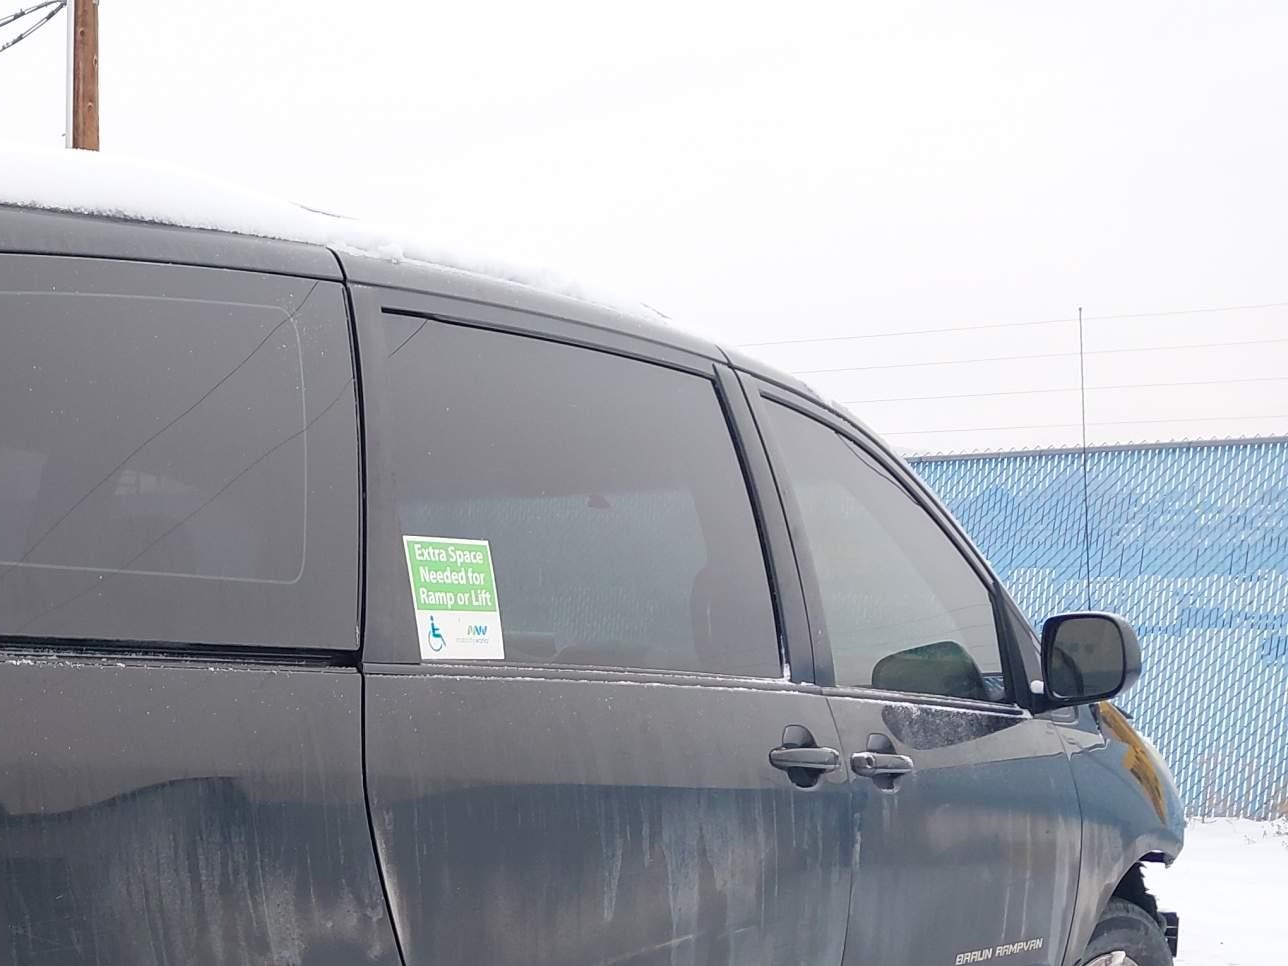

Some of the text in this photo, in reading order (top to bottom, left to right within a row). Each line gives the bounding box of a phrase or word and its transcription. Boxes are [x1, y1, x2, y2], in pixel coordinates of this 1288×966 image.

[414, 543, 483, 566] Extra Space
[419, 566, 485, 585] Needed for
[419, 587, 492, 609] Ramp or Lift
[955, 938, 1043, 965] BRAUN RAMPVAN
